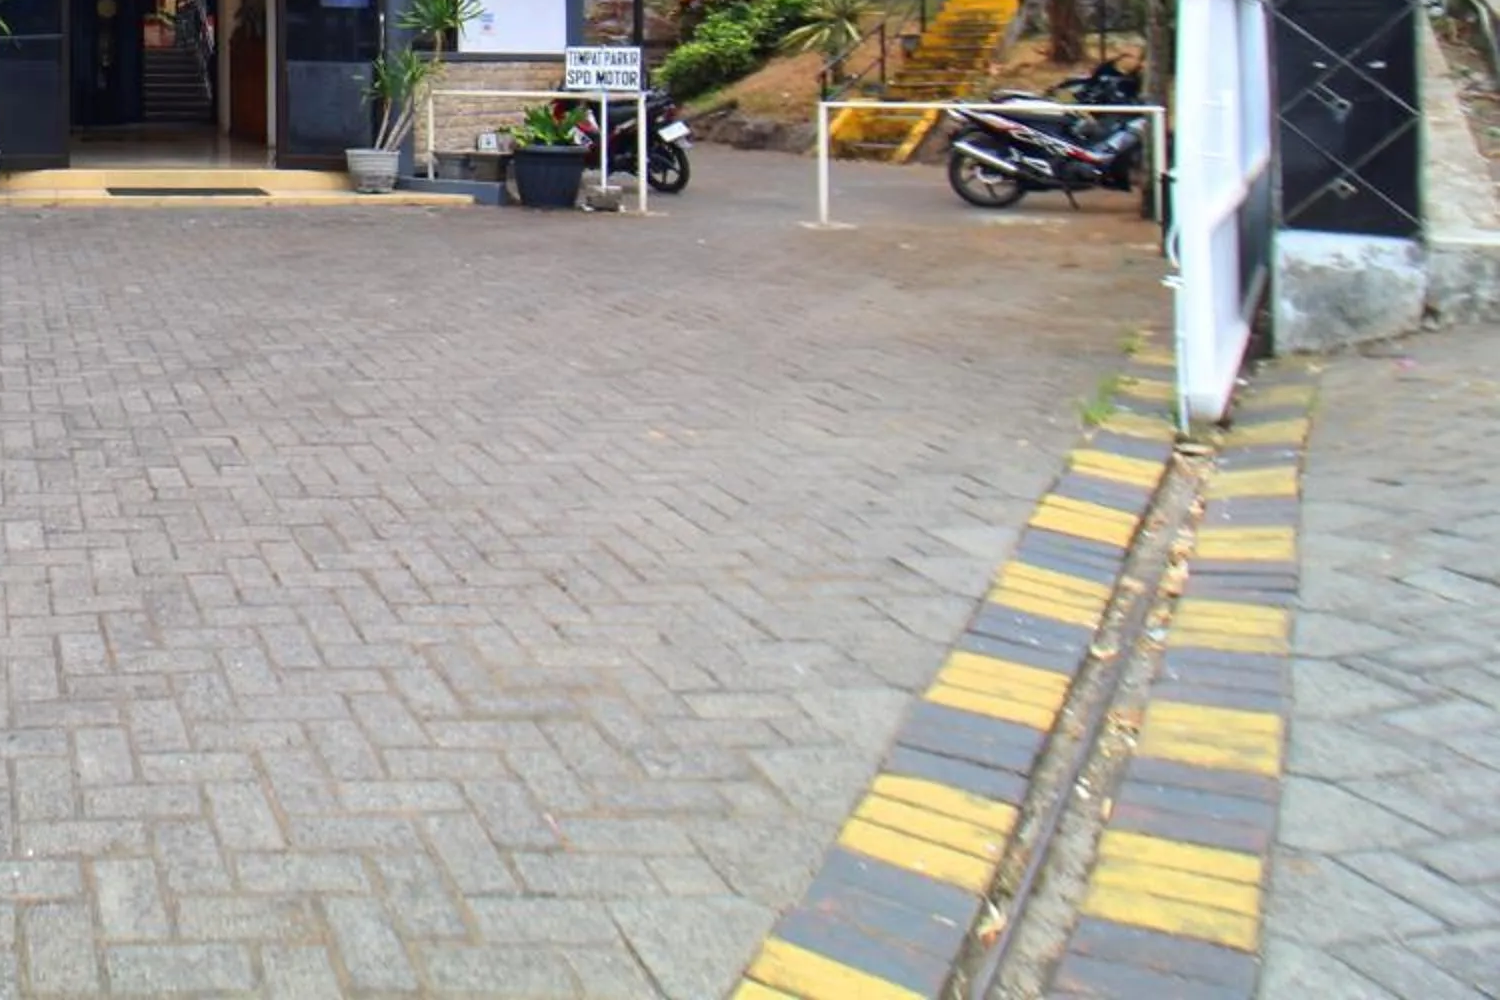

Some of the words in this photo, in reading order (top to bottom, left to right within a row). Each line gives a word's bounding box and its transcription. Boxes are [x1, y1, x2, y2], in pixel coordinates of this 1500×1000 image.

[569, 51, 603, 66] TEMPAT
[604, 51, 639, 66] PARKIR
[596, 70, 638, 86] MOTOR
